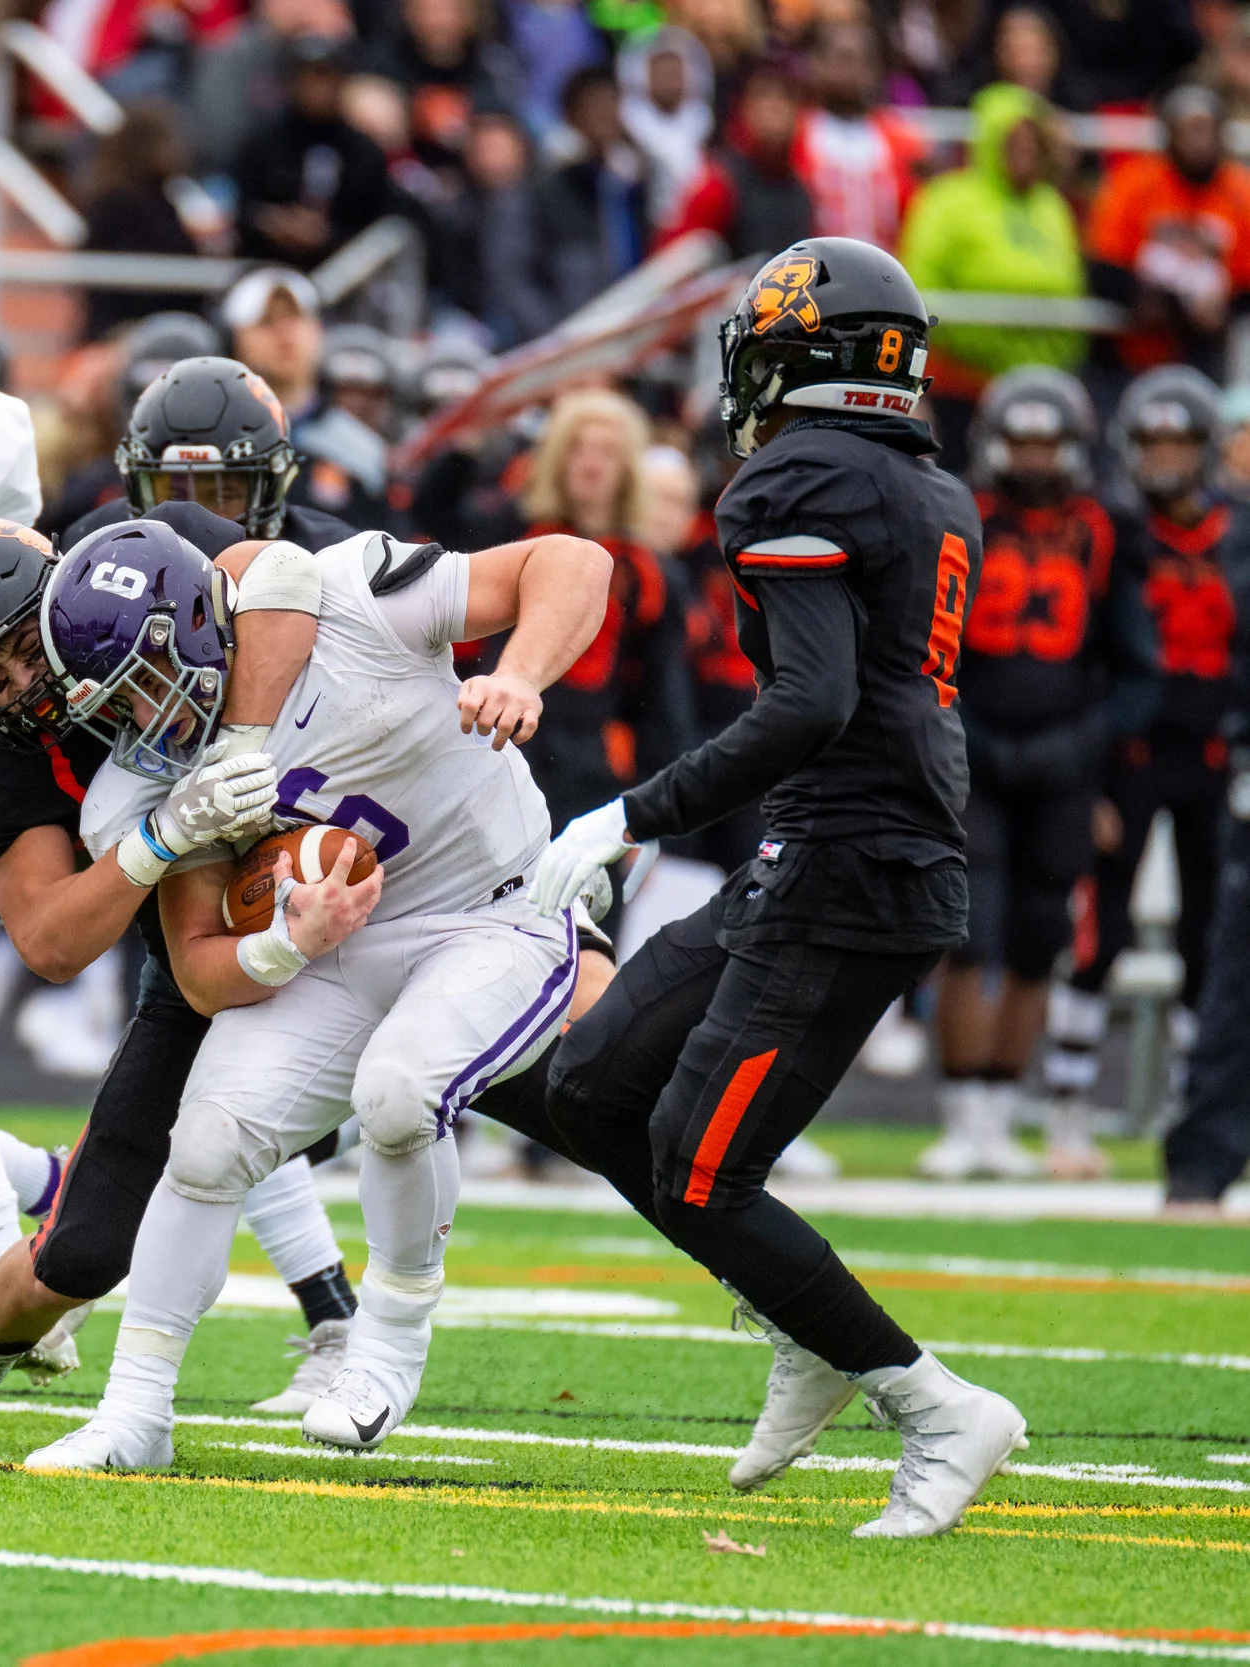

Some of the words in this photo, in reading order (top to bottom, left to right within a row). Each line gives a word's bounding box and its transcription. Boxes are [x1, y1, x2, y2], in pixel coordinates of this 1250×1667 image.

[877, 329, 903, 373] 8
[844, 391, 880, 406] THE
[90, 562, 148, 600] 6
[273, 766, 410, 864] 6
[244, 875, 274, 900] GST
